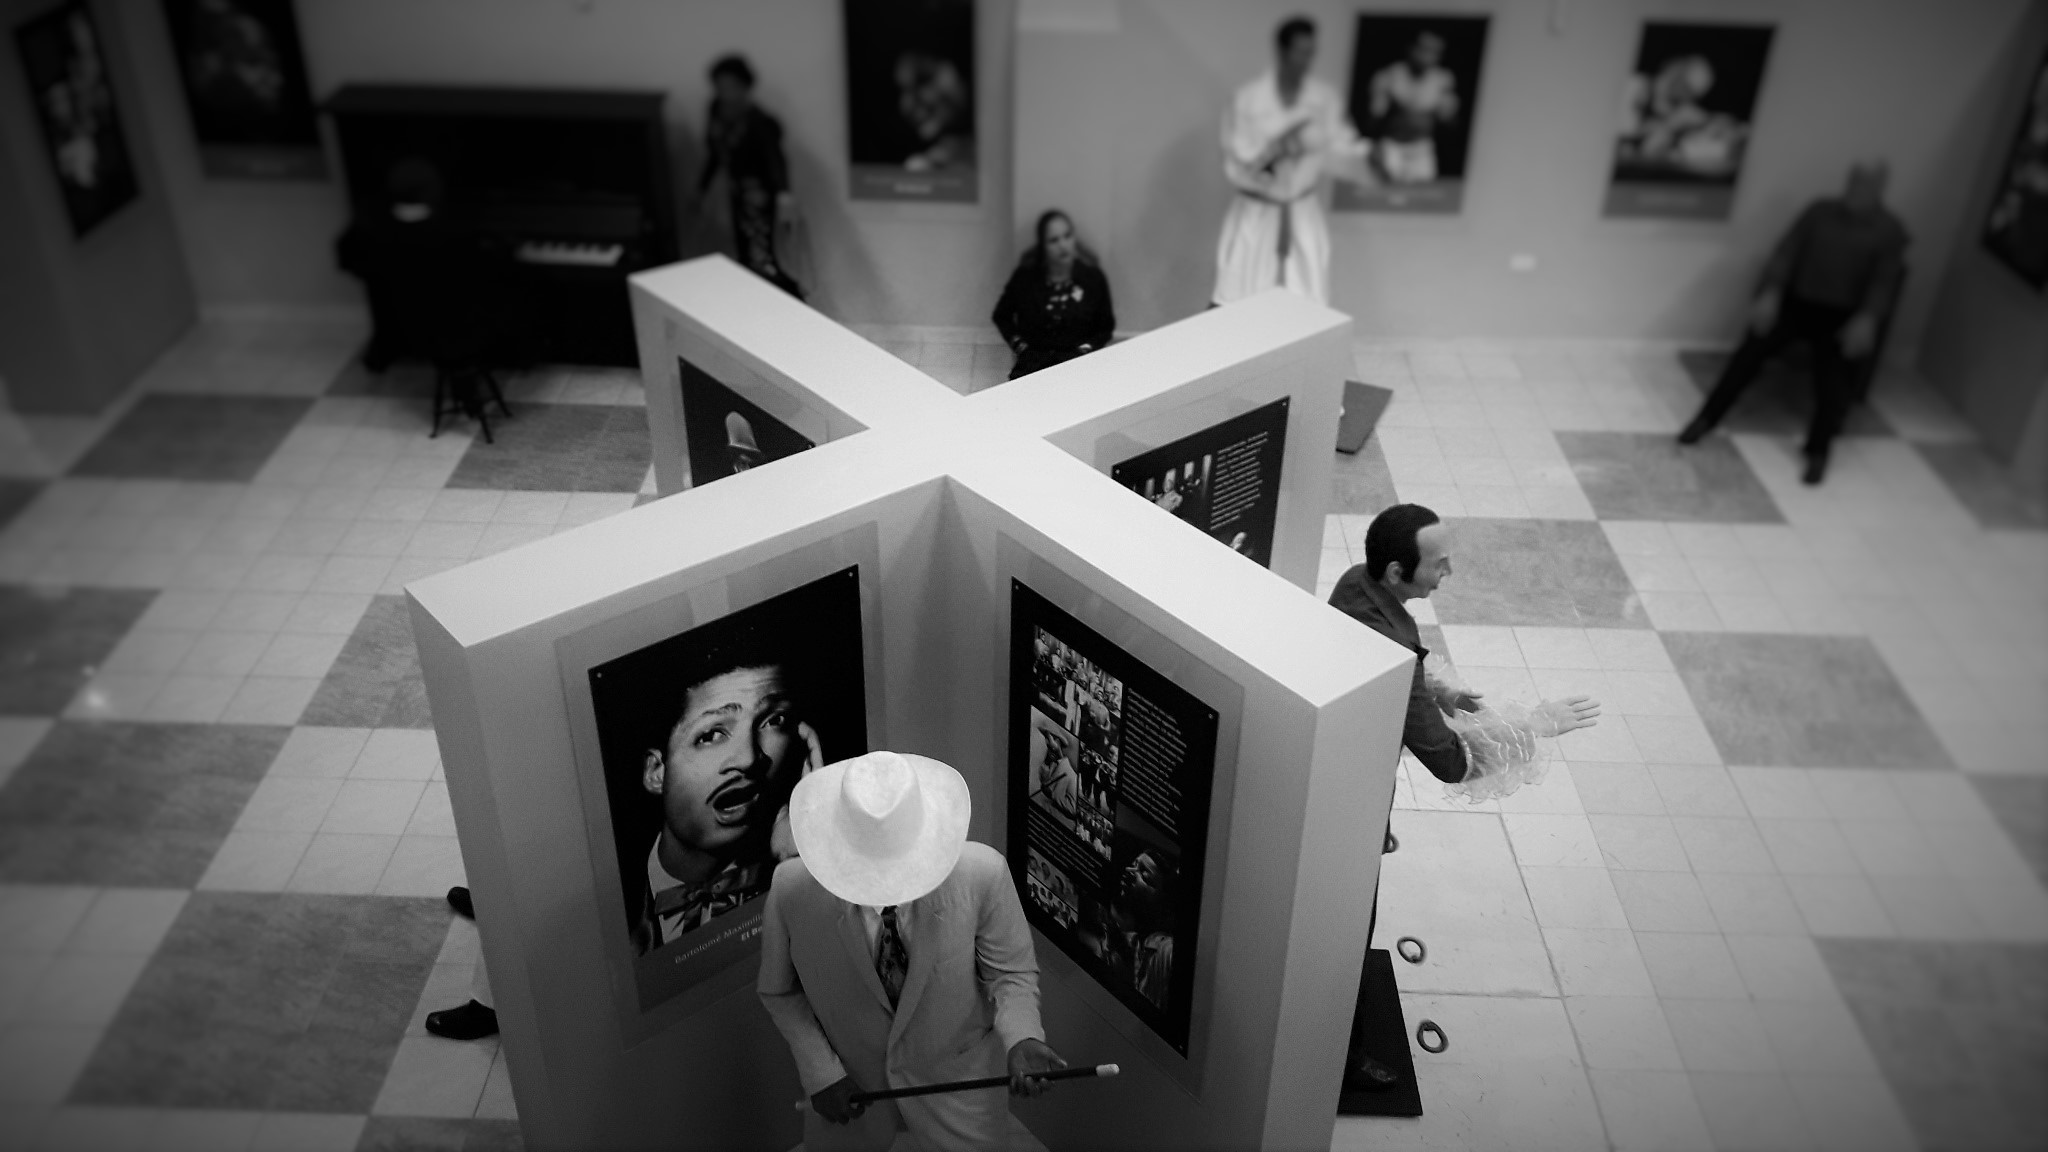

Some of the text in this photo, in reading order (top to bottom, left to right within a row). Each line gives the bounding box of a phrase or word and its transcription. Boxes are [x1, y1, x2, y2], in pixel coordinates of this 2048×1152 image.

[674, 913, 763, 964] Bartolomé Maximili
[740, 931, 750, 942] El
